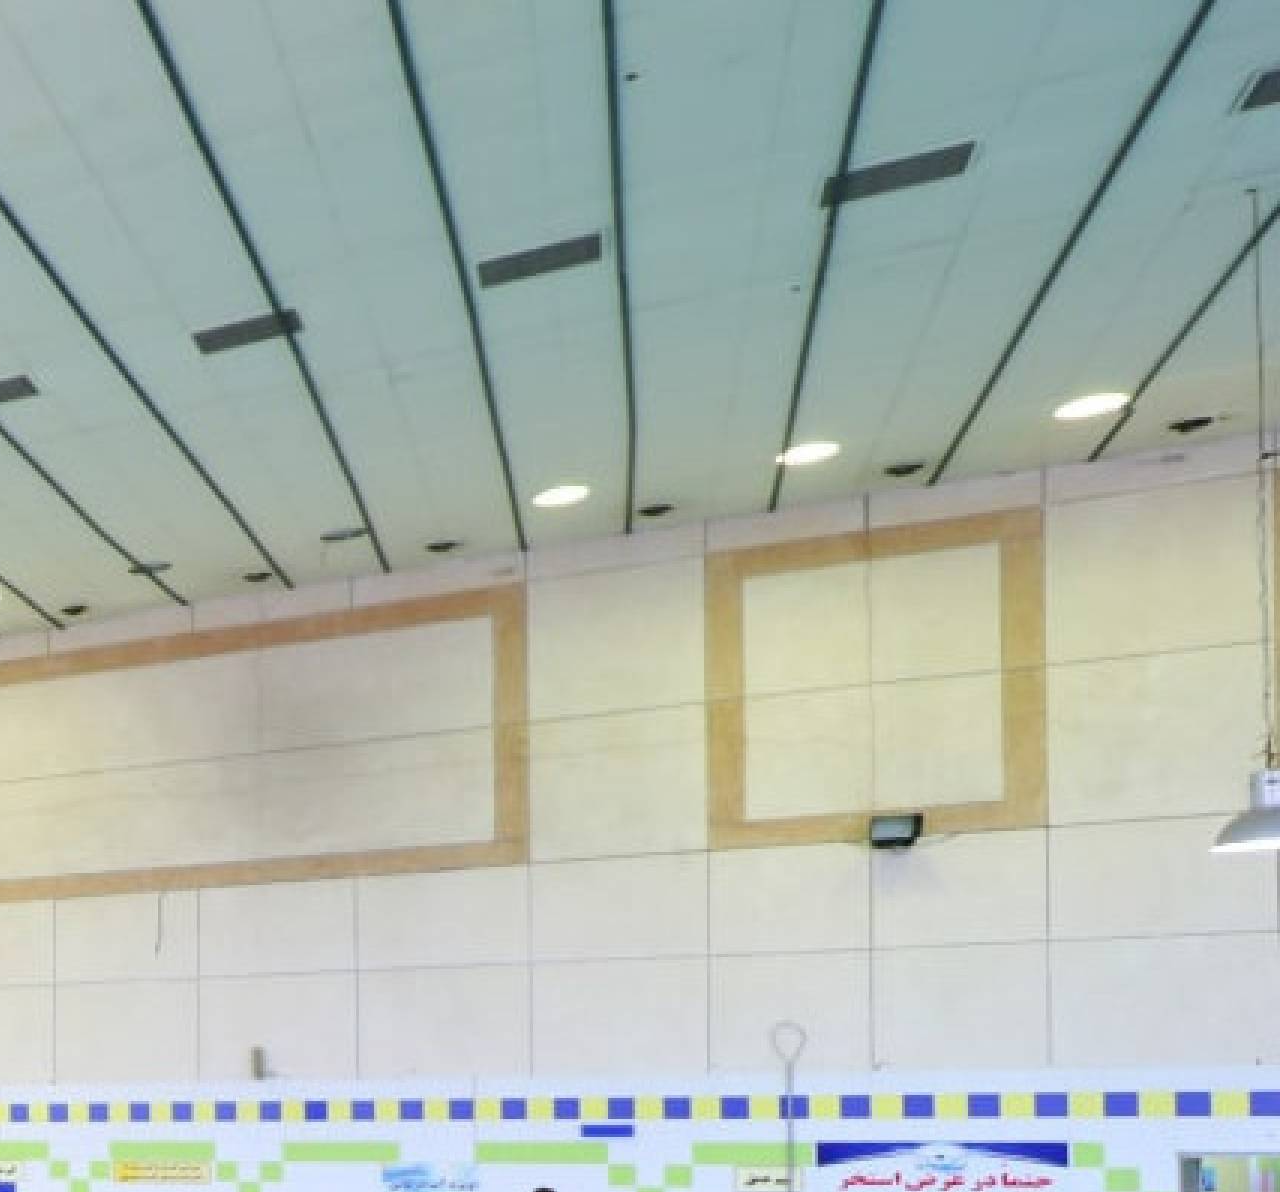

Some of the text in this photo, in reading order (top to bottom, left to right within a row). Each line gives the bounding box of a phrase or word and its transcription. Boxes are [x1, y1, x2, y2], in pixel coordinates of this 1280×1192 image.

[838, 1170, 900, 1191] استخر
[904, 1174, 965, 1192] عرض
[970, 1174, 996, 1192] در
